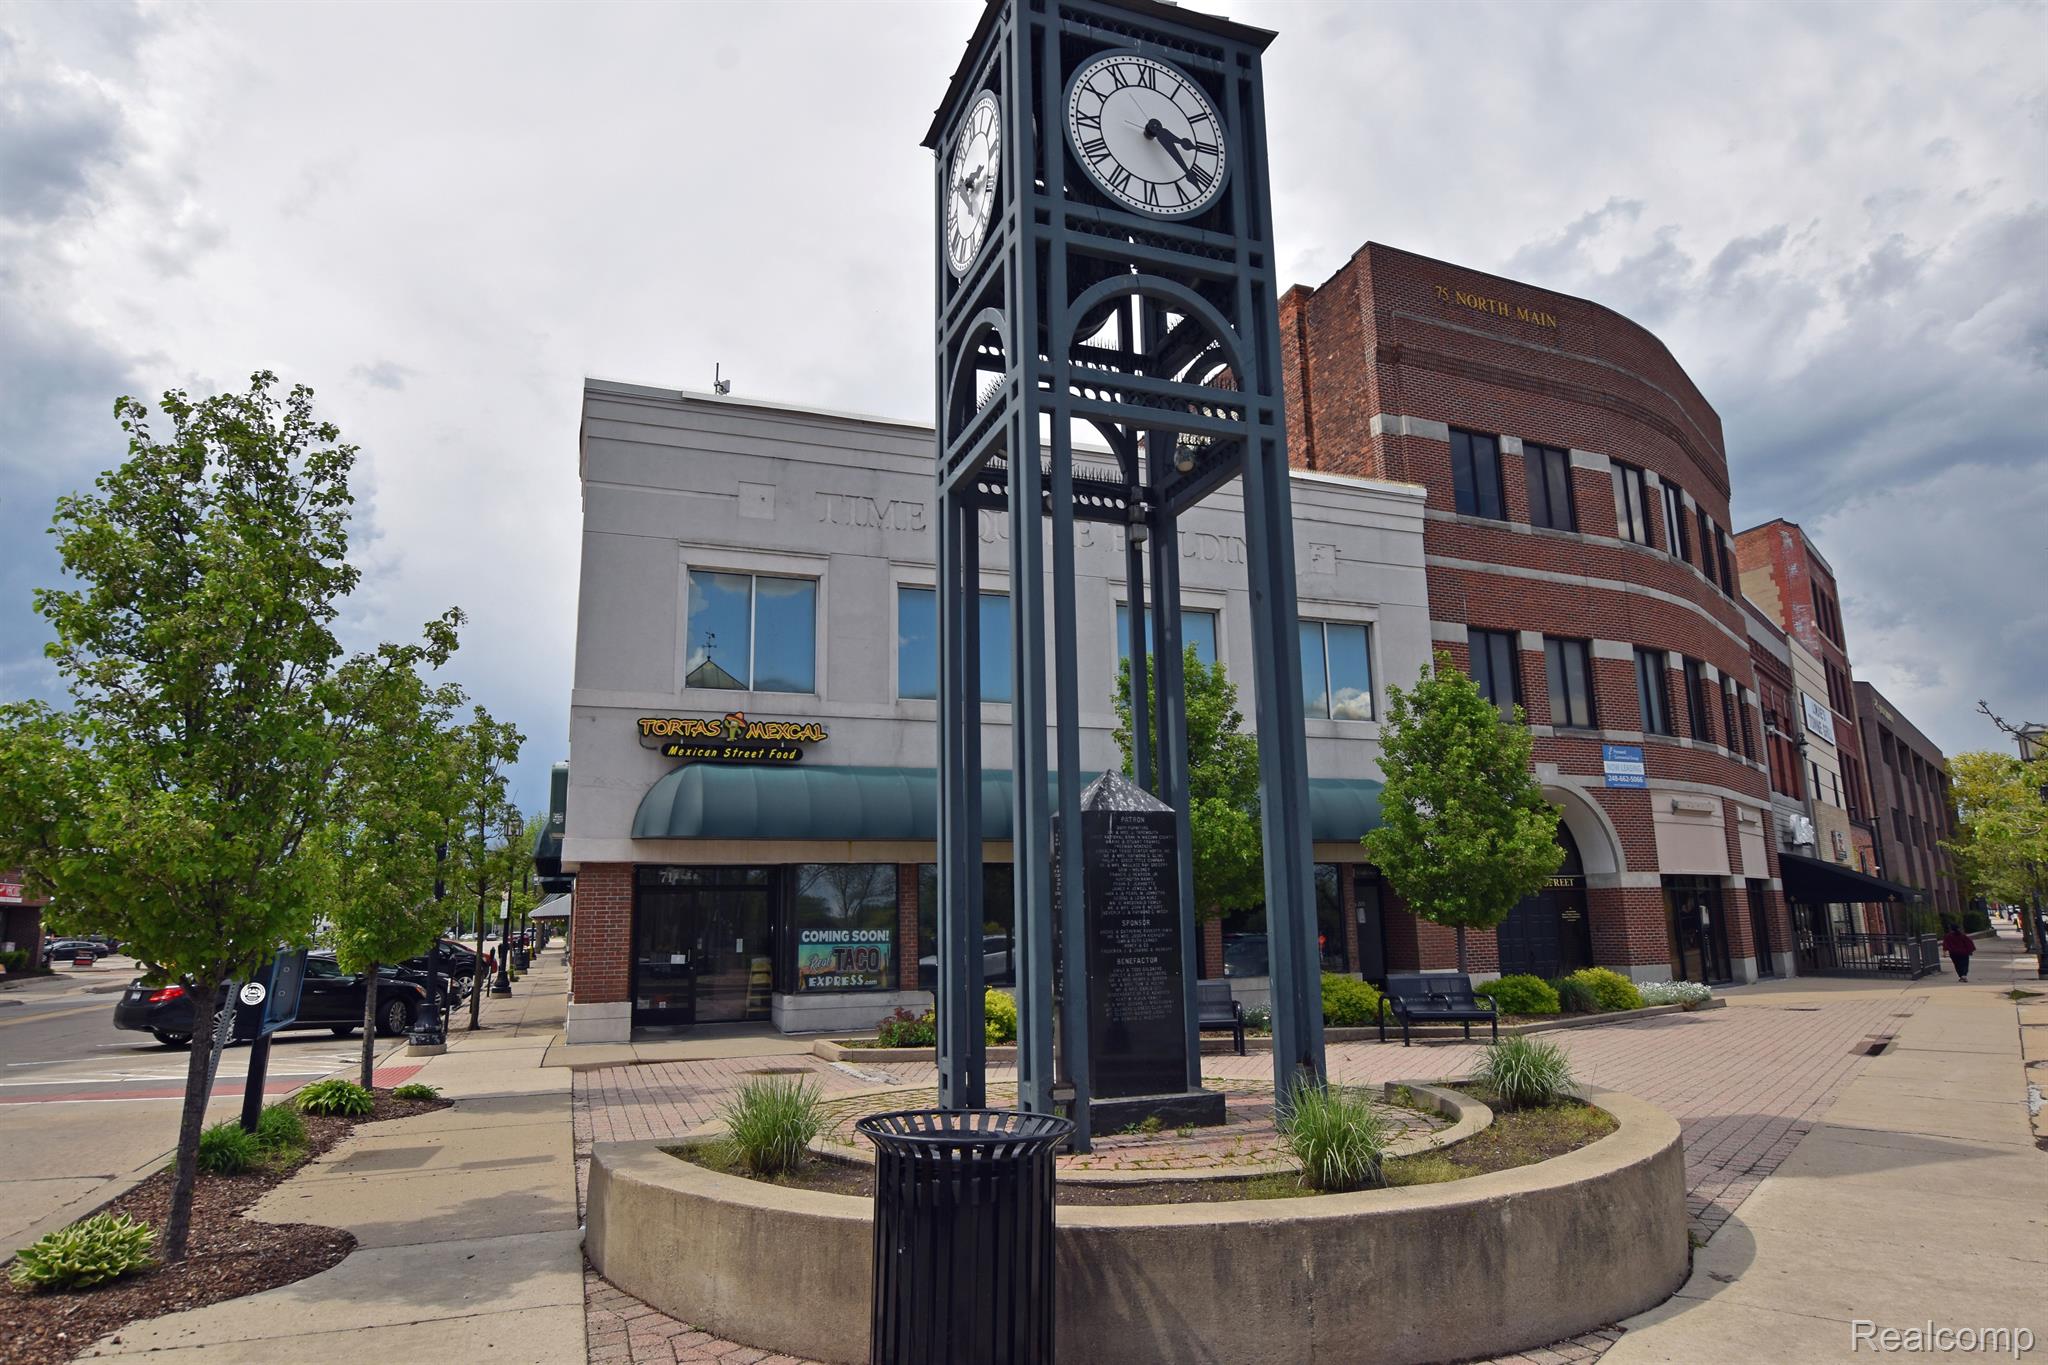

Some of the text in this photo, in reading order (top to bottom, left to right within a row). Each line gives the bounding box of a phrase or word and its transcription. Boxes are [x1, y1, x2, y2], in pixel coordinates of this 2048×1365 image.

[1137, 65, 1156, 90] XII
[1083, 81, 1108, 104] X
[1435, 285, 1556, 328] 75 NORTH MAIN
[815, 491, 926, 531] TIME
[638, 718, 828, 742] TORTAS MEXCAL
[667, 746, 796, 760] Mexican Street Food
[1121, 919, 1151, 927] SPONSOR
[801, 929, 890, 943] COMING SOON!
[832, 945, 881, 972] TACO
[1117, 957, 1158, 965] BENEFACTOR
